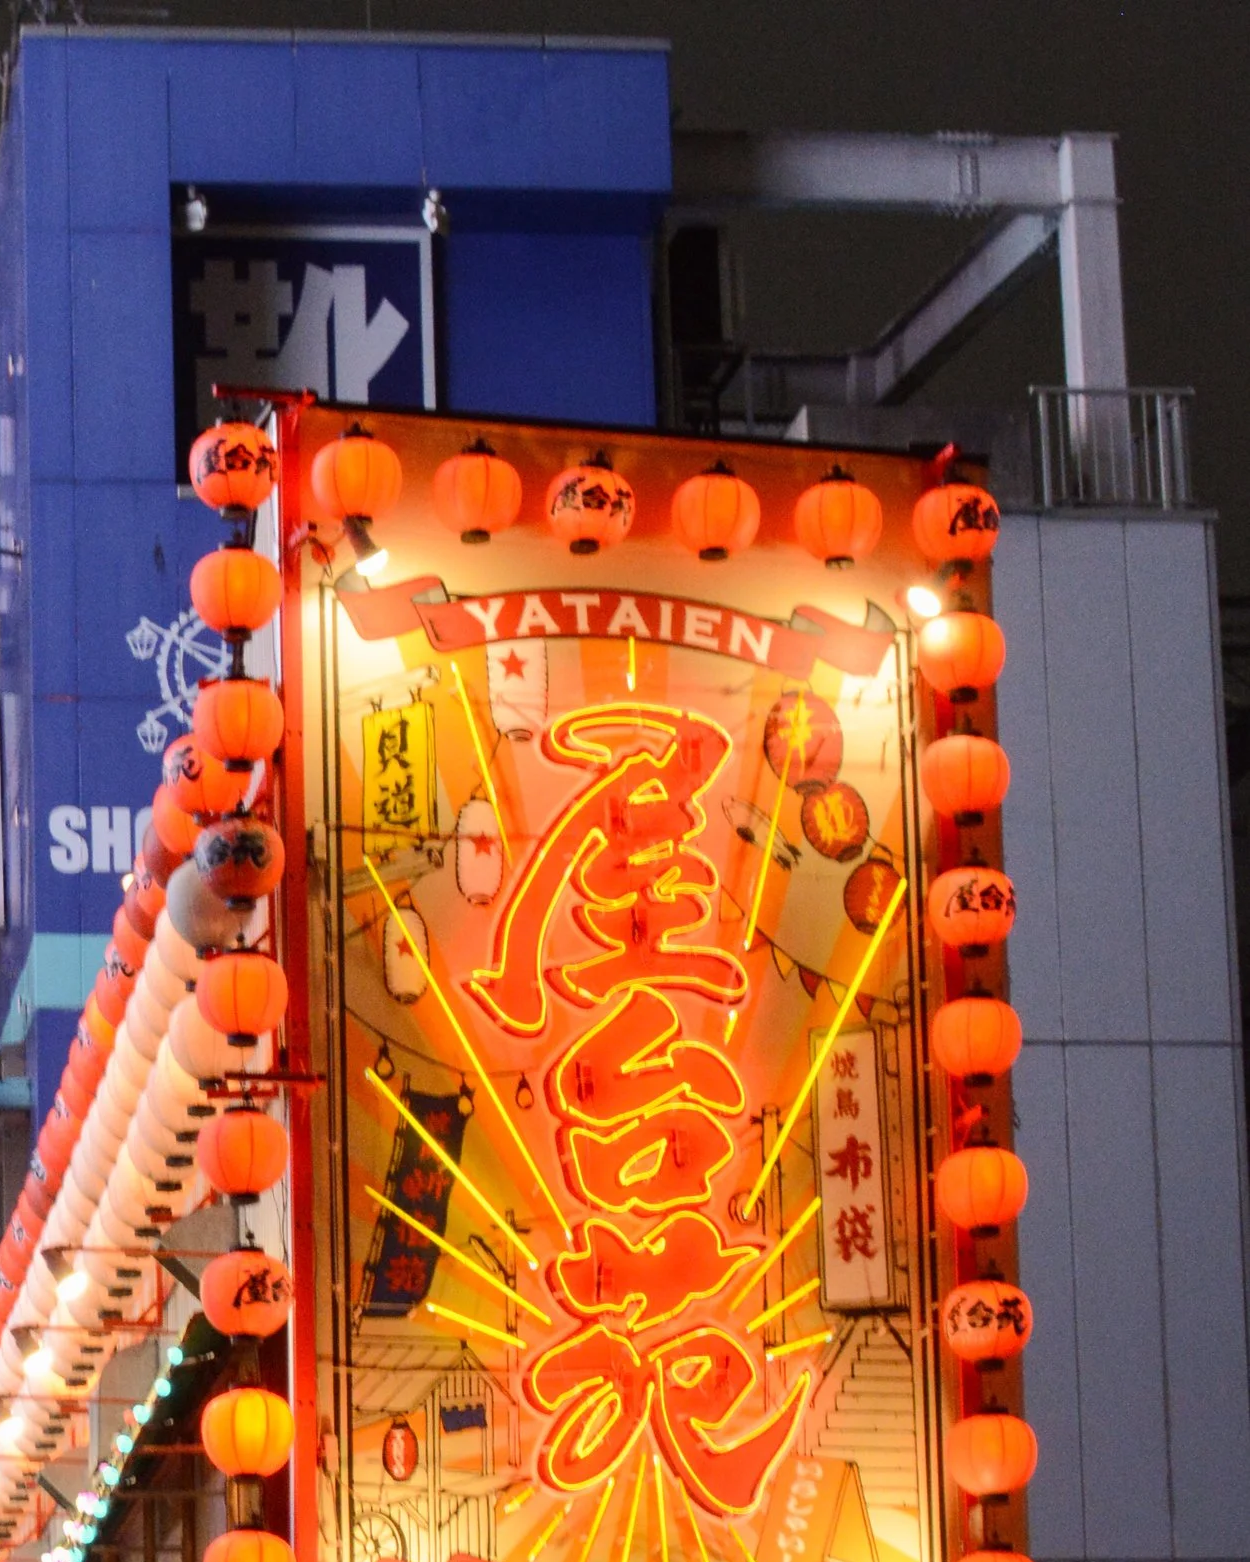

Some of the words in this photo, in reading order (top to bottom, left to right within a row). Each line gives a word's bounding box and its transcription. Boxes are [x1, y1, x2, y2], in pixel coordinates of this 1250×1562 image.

[463, 593, 773, 664] YATAIEN
[48, 804, 153, 874] SH
[464, 702, 812, 1518] 屋台苑
